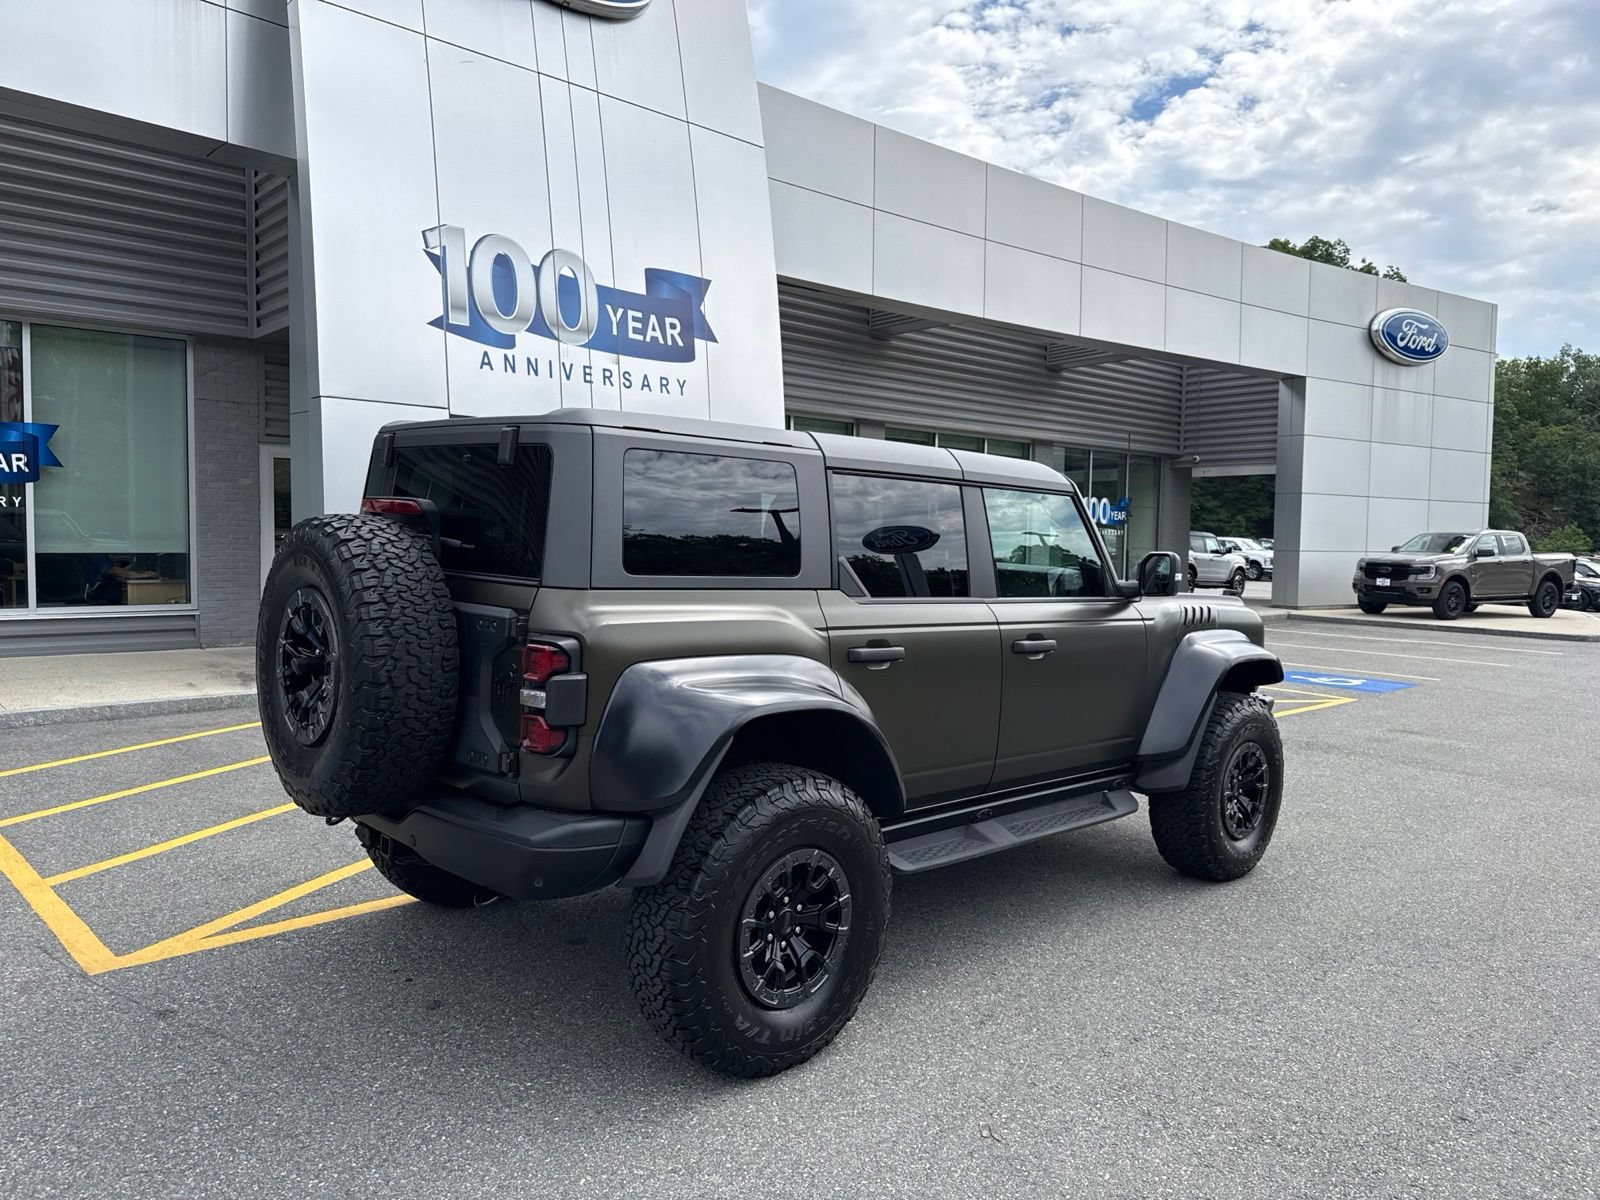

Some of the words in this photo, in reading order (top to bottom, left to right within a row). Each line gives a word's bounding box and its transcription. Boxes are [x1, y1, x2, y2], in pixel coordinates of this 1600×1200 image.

[421, 224, 599, 346] 100
[605, 303, 684, 347] YEAR
[1397, 319, 1438, 353] Ford
[479, 350, 687, 397] ANNIVERSARY
[1110, 510, 1127, 520] YEAR
